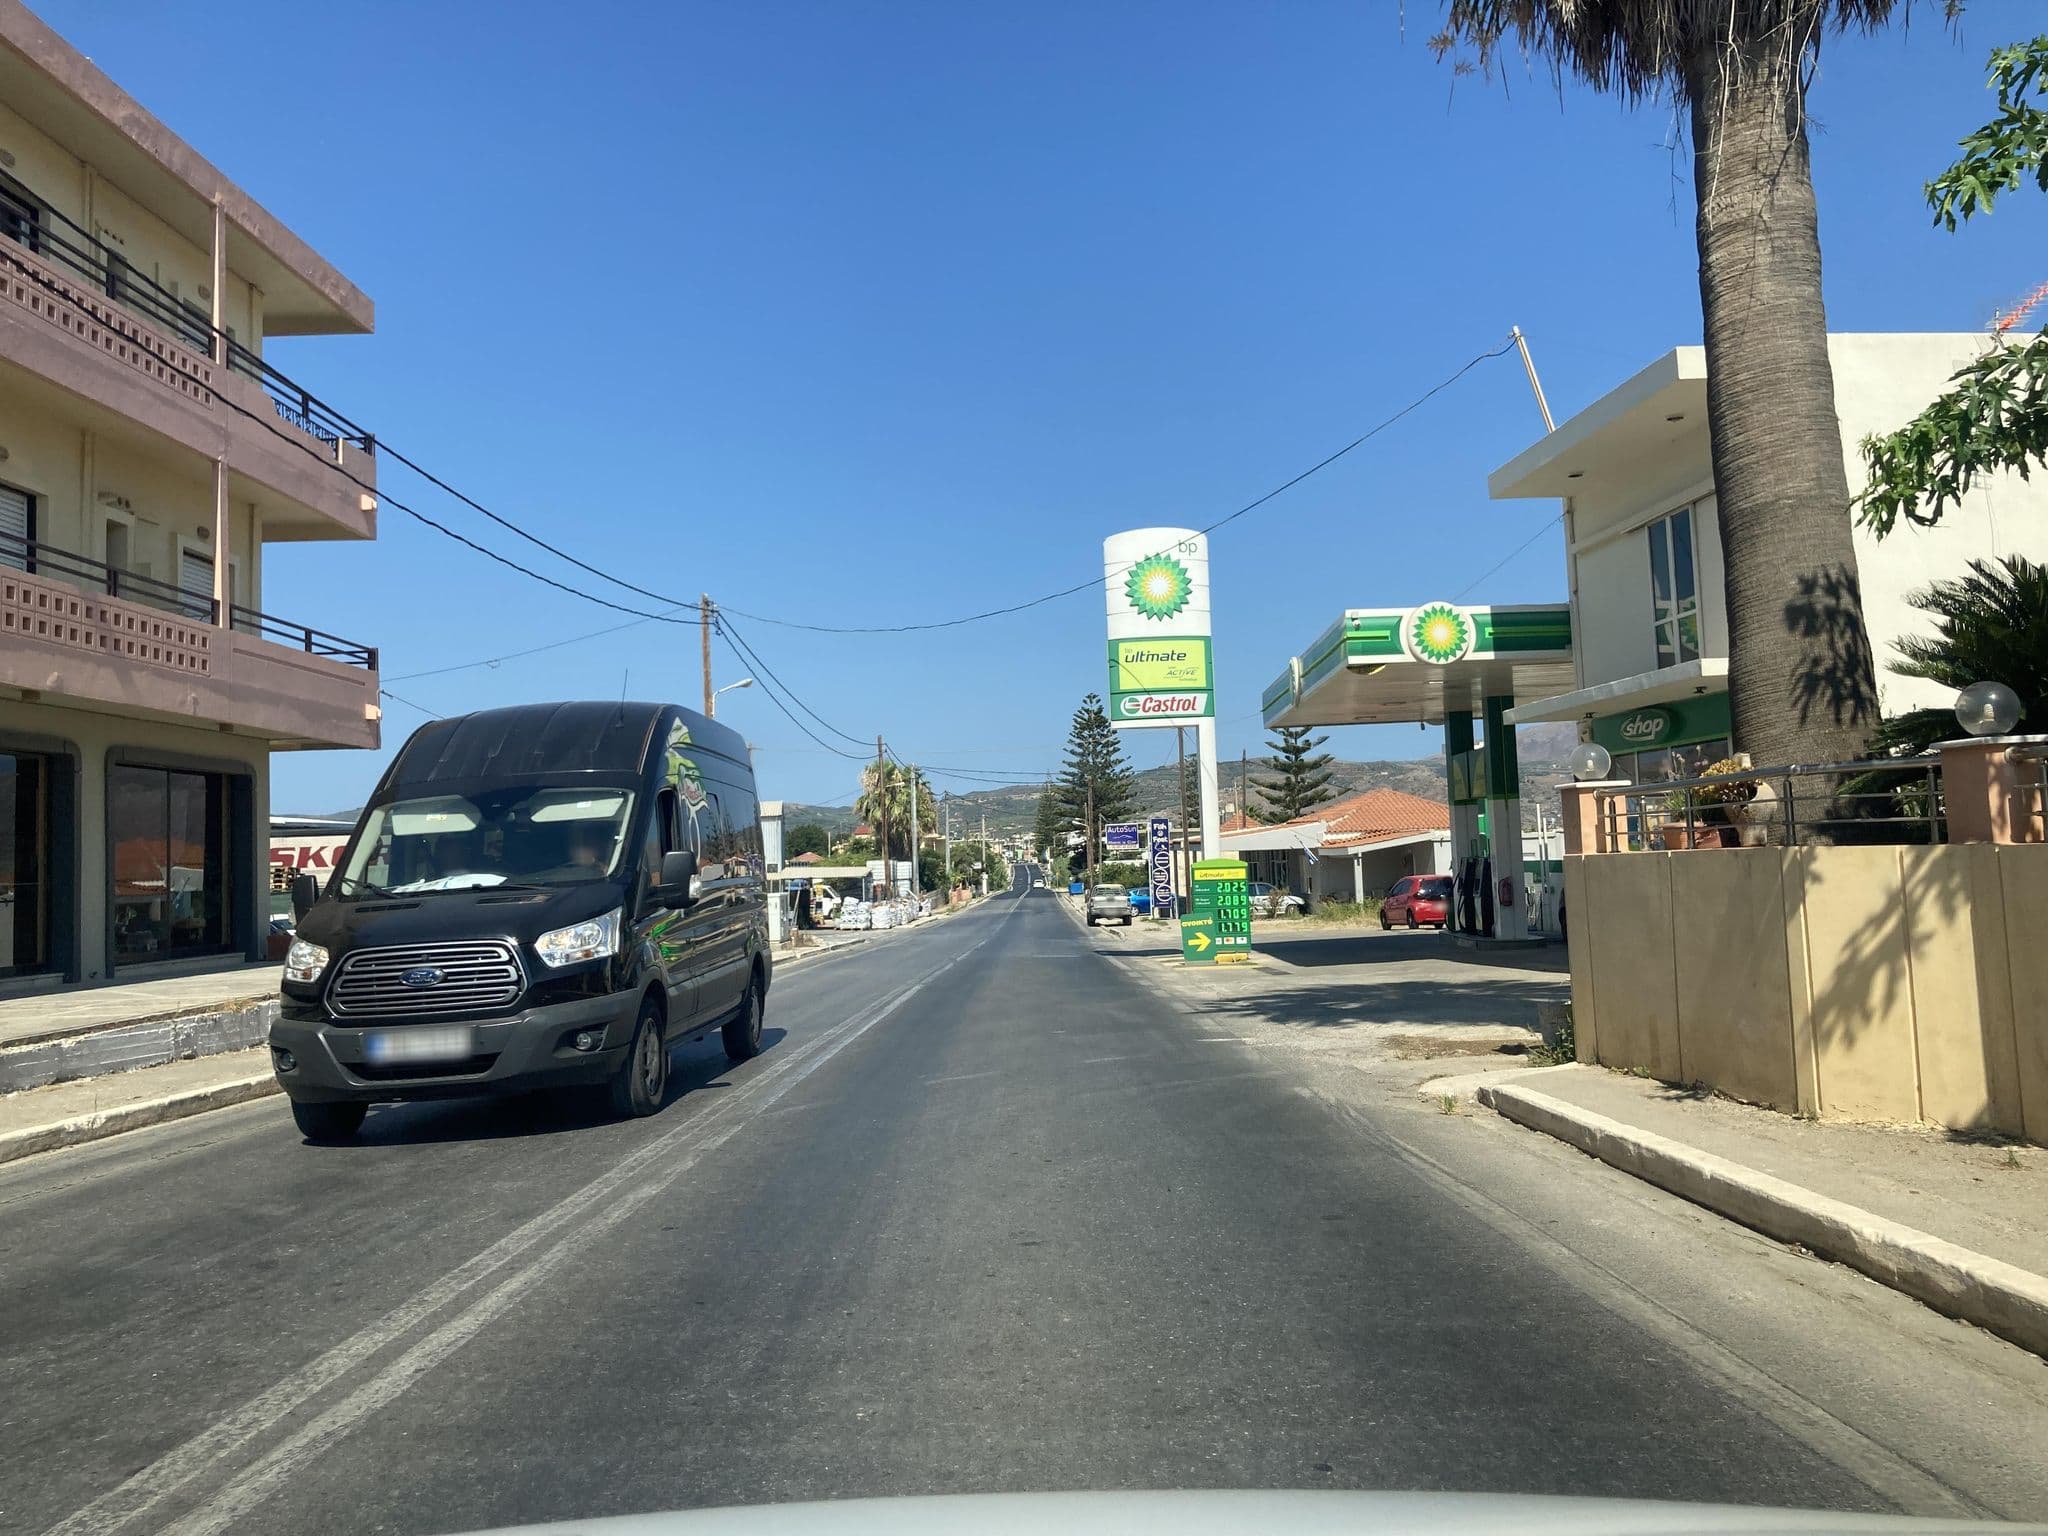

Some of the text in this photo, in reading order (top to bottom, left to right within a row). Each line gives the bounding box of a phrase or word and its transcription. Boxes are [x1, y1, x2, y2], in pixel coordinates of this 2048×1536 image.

[1178, 539, 1198, 556] bp
[1125, 649, 1187, 663] ultimate
[1141, 696, 1197, 713] Castrol
[1624, 714, 1664, 739] shop
[1107, 825, 1137, 833] AutoSun
[1217, 882, 1246, 893] 2.025
[1217, 895, 1247, 906] 2.089
[1220, 908, 1247, 919] 1.709
[1221, 922, 1248, 932] 1.779
